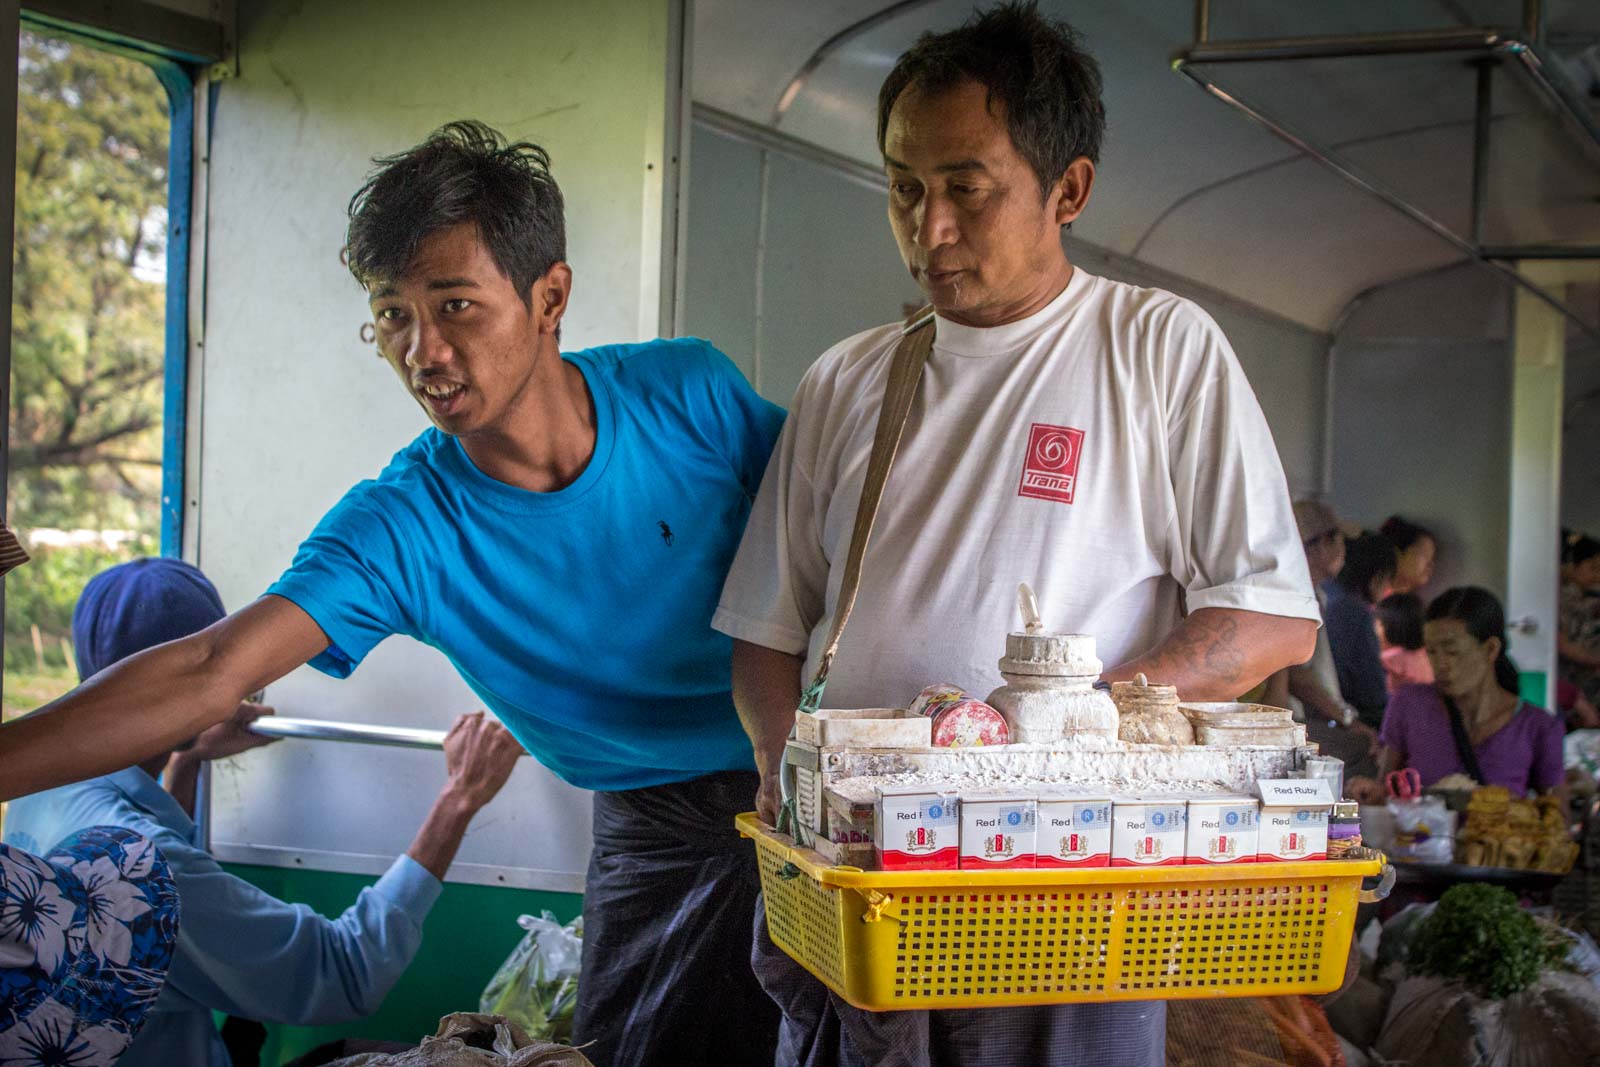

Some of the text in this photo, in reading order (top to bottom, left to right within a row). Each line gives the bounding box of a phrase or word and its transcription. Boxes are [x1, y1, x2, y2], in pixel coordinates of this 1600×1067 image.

[1026, 471, 1071, 490] Trane
[1273, 786, 1318, 796] Red Ruby
[896, 811, 917, 820] Red
[975, 818, 996, 827] Red
[1051, 818, 1071, 827] Red
[1126, 821, 1146, 829] Red
[1201, 820, 1220, 829] Red
[1271, 817, 1290, 826] Red
